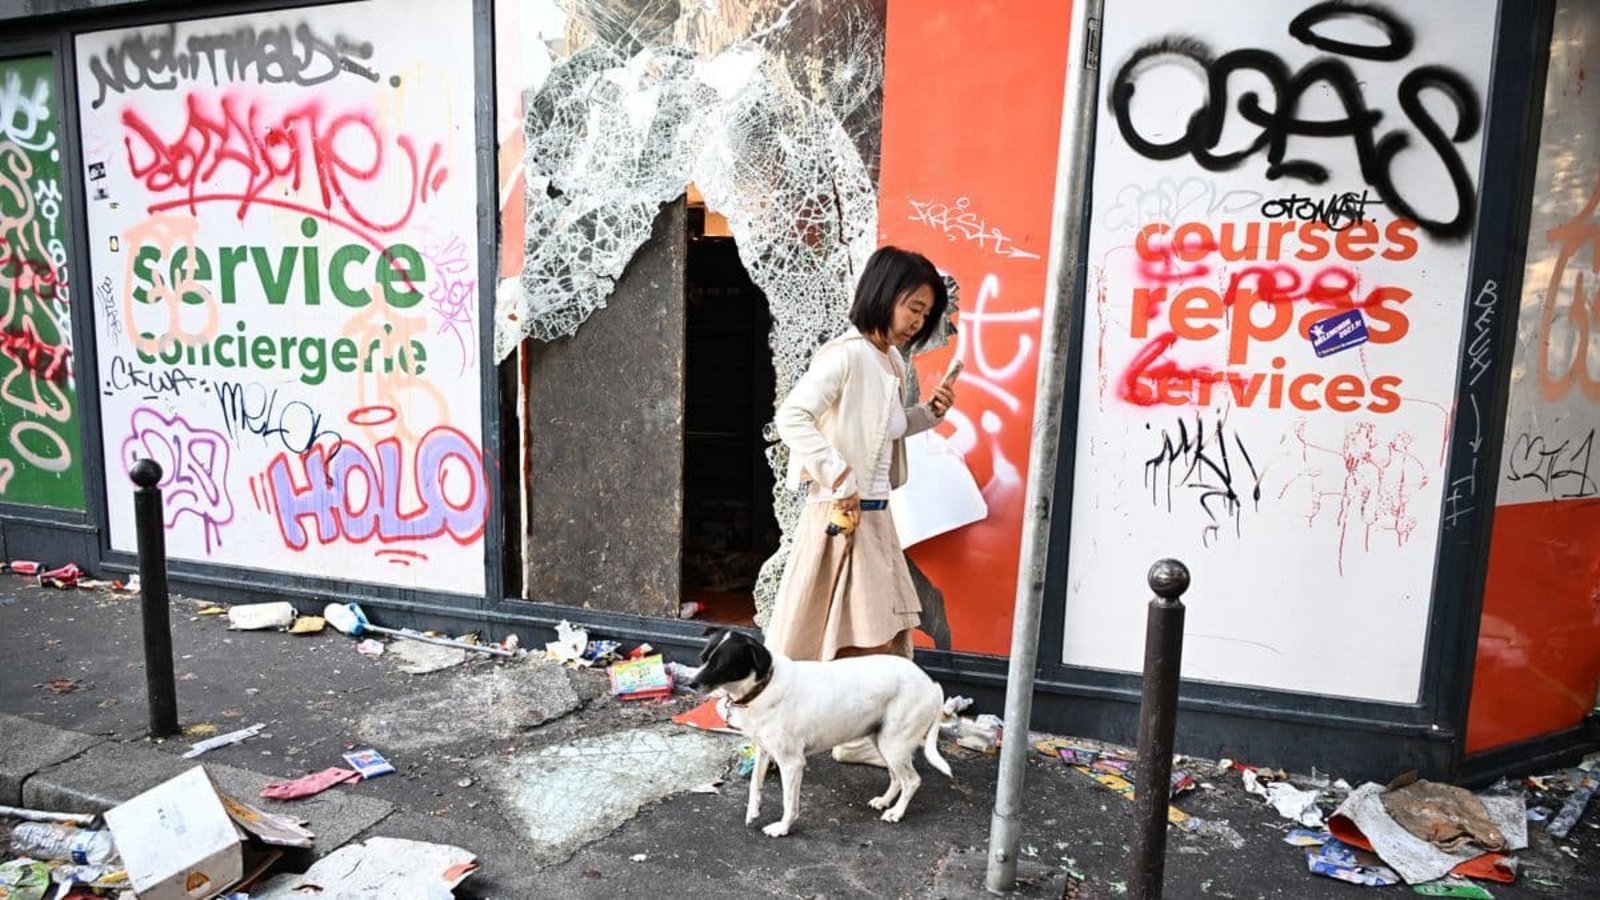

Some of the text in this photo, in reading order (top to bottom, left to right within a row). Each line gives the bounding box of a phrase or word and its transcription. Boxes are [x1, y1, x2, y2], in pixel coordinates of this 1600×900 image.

[132, 217, 426, 308] service
[1136, 216, 1419, 263] courses
[136, 320, 427, 385] conciergerie
[1131, 356, 1403, 414] services
[268, 425, 490, 551] HOLO
